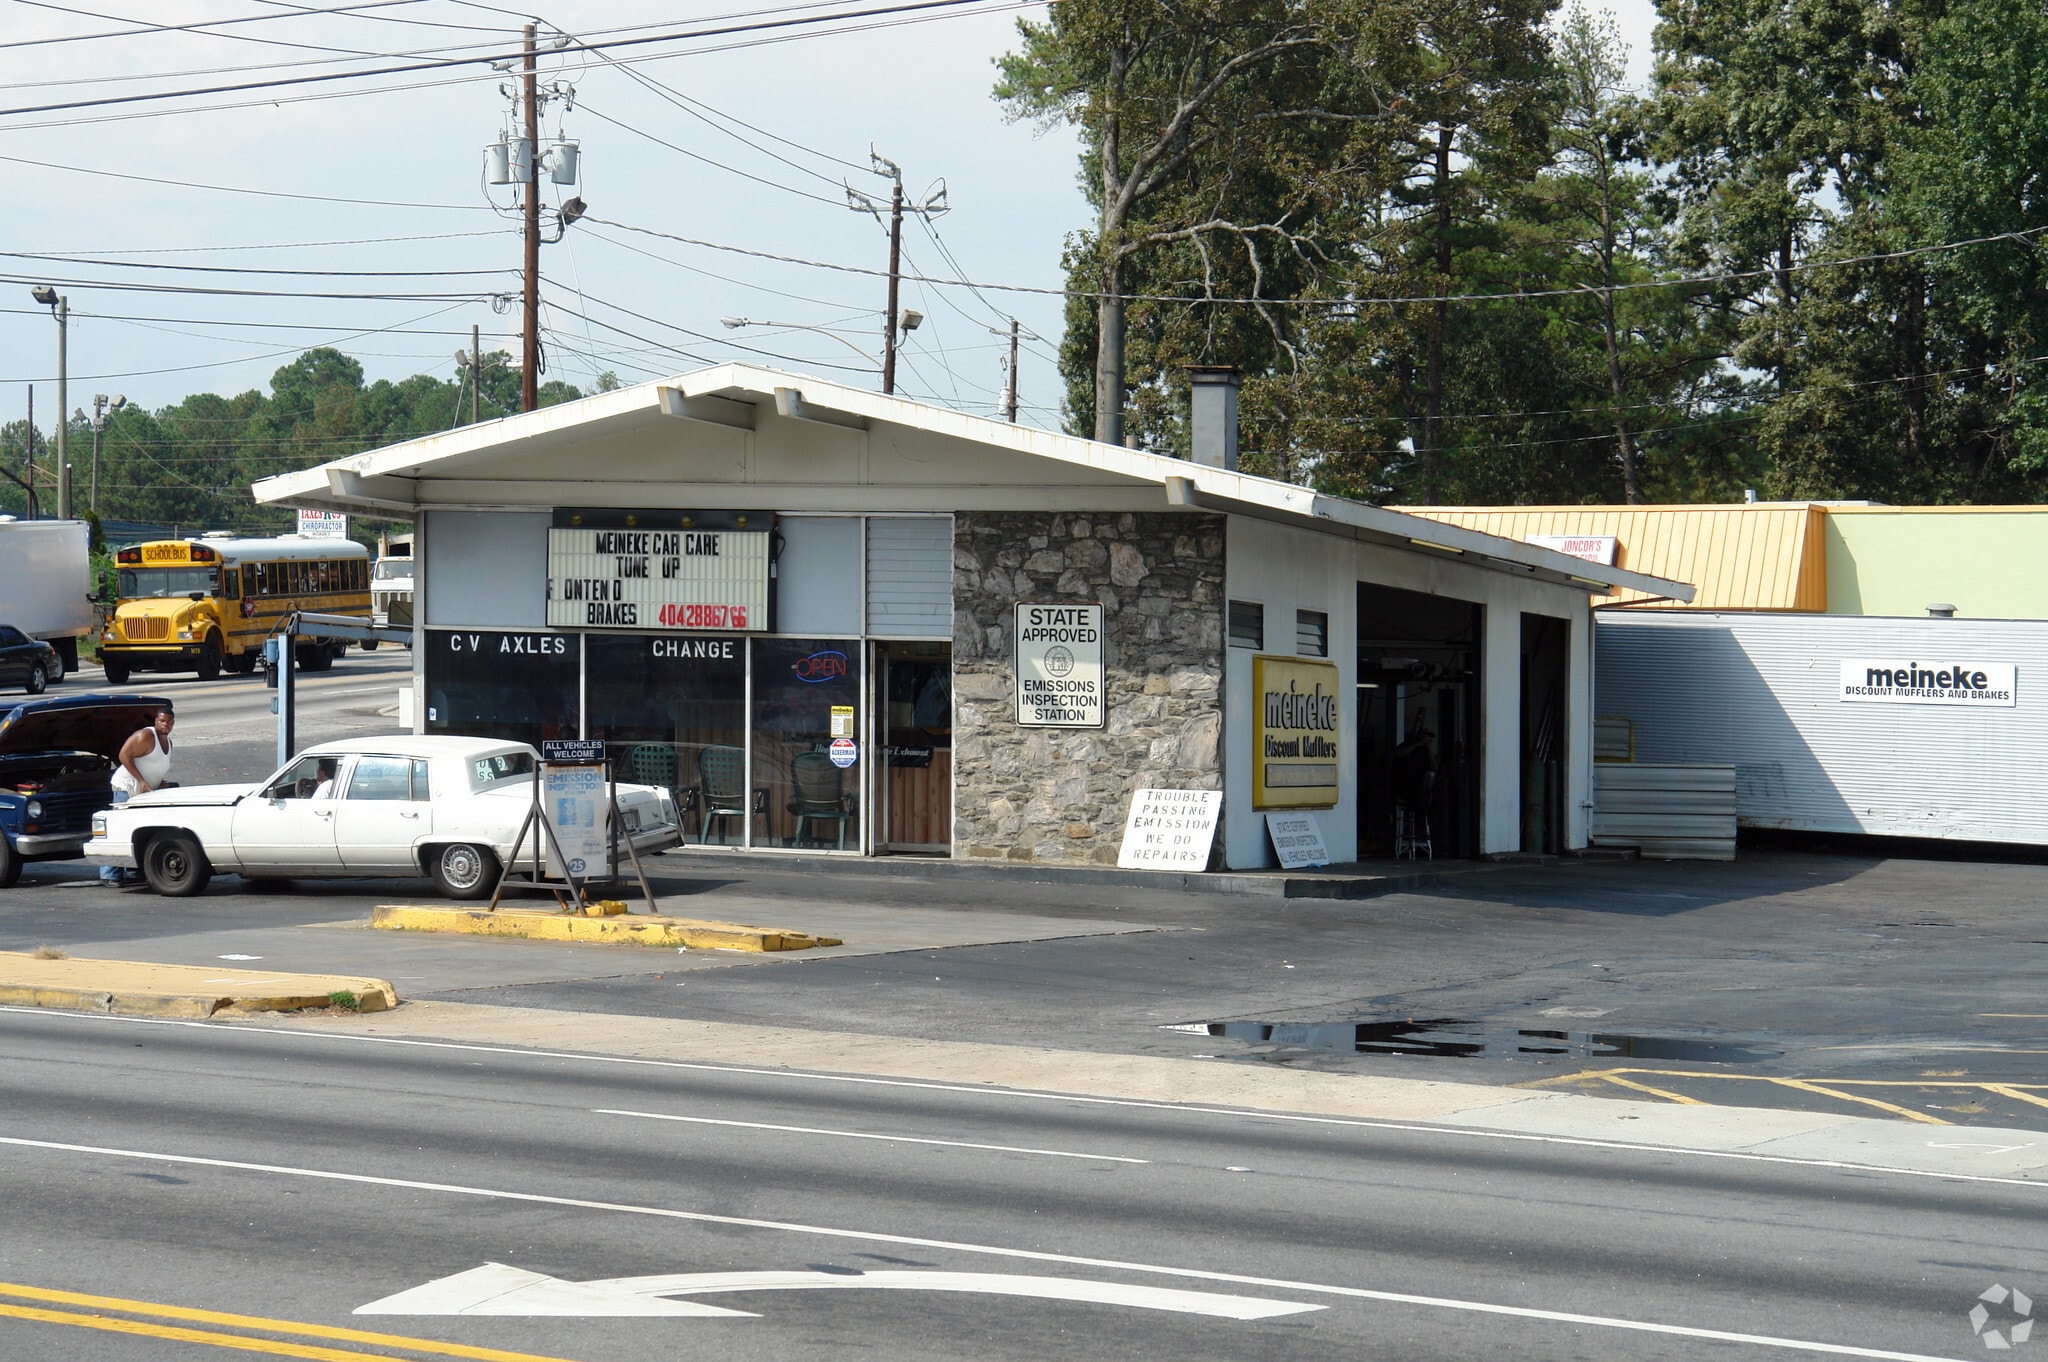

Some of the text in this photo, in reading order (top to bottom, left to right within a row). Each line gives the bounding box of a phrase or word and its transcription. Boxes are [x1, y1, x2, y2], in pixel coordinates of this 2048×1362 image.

[302, 522, 343, 530] CHIROPRACTOR
[596, 532, 719, 556] MEINEKE CAR CARE
[1562, 540, 1602, 552] JONCOR'S
[146, 548, 187, 560] SCHOOL BUS
[616, 556, 681, 579] TUNE UP
[587, 603, 637, 625] BRAKES
[1030, 608, 1089, 626] STATE
[1022, 628, 1097, 643] APPROVED
[500, 637, 566, 654] AXLES
[652, 640, 735, 659] CHANGE
[795, 657, 846, 677] OPEN
[1866, 661, 1988, 690] meineke
[1024, 680, 1095, 693] EMISSIONS
[1845, 686, 2010, 700] DISCOUNT MUFFLERS AND BRAKES
[1022, 694, 1098, 707] INSPECTION
[1265, 679, 1337, 731] meineke
[1035, 708, 1085, 721] STATION
[545, 741, 603, 750] ALL VEHICLES
[1265, 734, 1337, 759] Discount Mufflers
[553, 750, 595, 758] WELCOME
[1146, 790, 1211, 804] TROUBLE
[1142, 804, 1207, 816] PASSING
[1134, 817, 1211, 830] EMISSION
[1145, 834, 1192, 845] WE DO
[1133, 849, 1198, 861] REPAIRS
